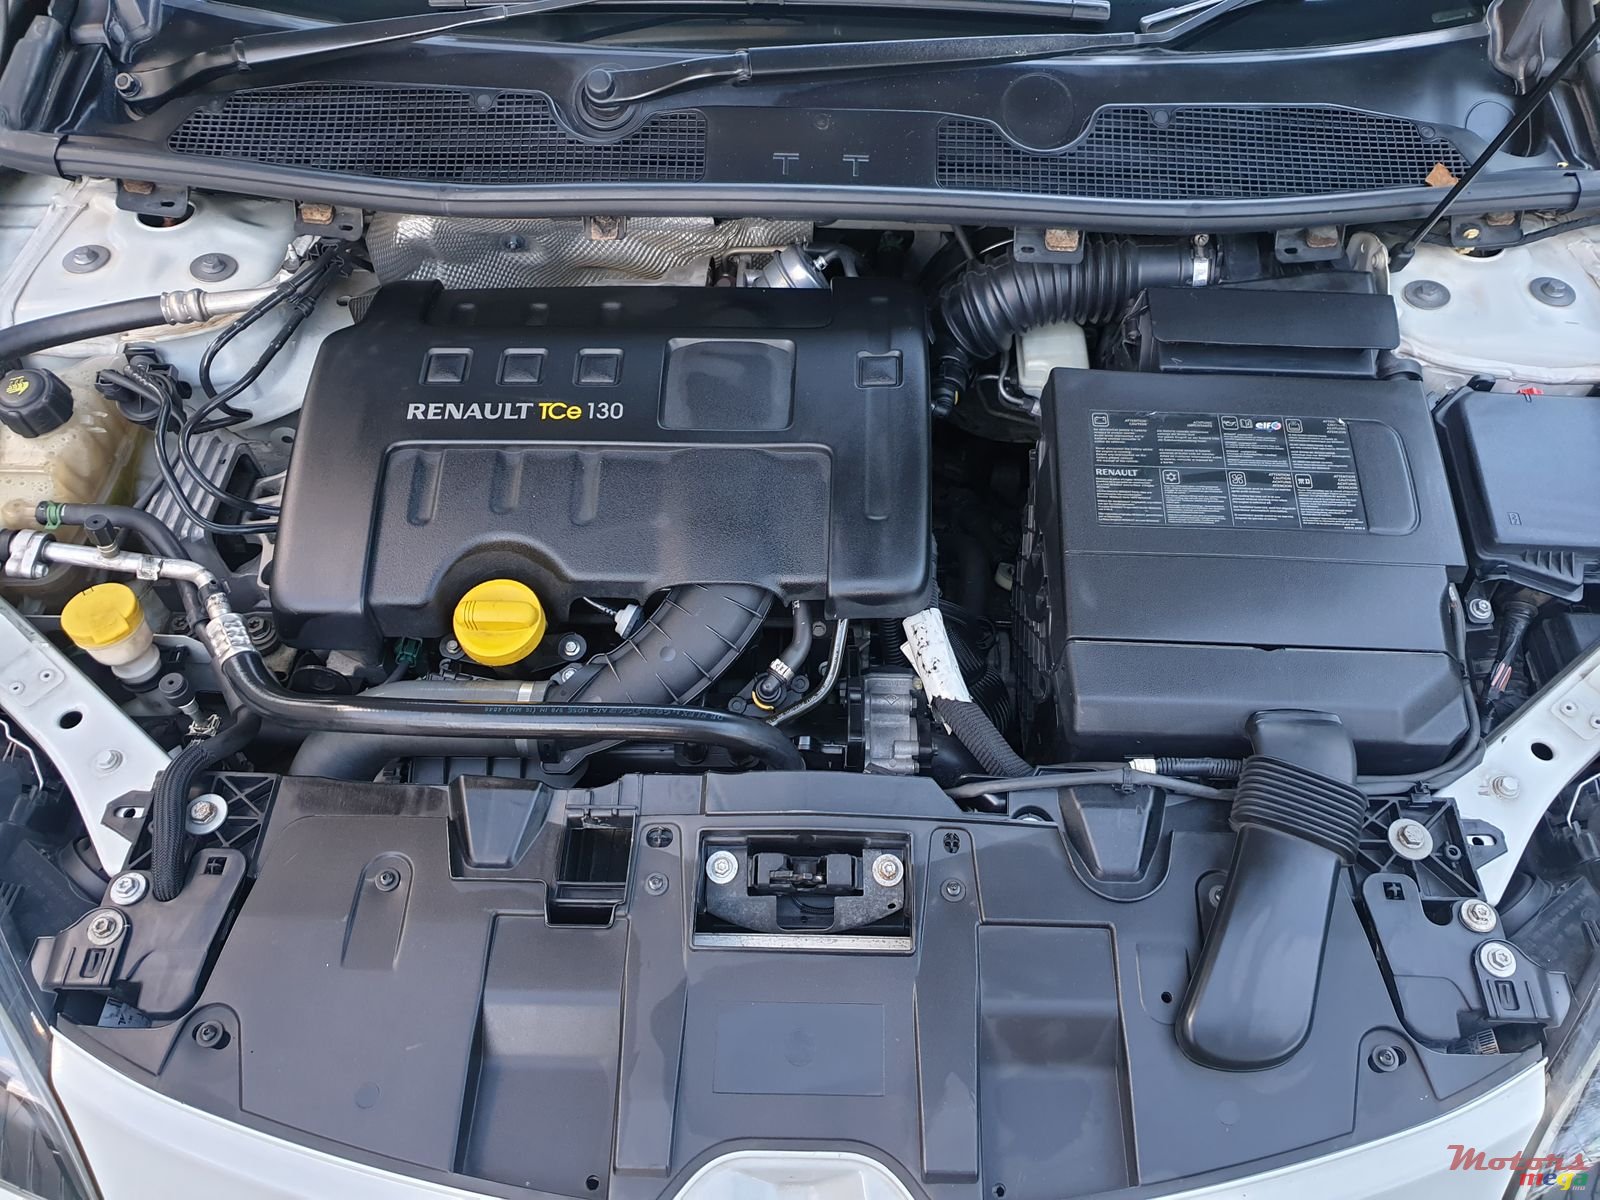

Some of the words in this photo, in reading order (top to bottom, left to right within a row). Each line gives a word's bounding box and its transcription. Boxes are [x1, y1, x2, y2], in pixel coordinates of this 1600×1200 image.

[406, 402, 534, 420] RENAULT
[538, 402, 583, 420] TCe
[587, 402, 624, 419] 130
[1095, 468, 1139, 477] RENAULT
